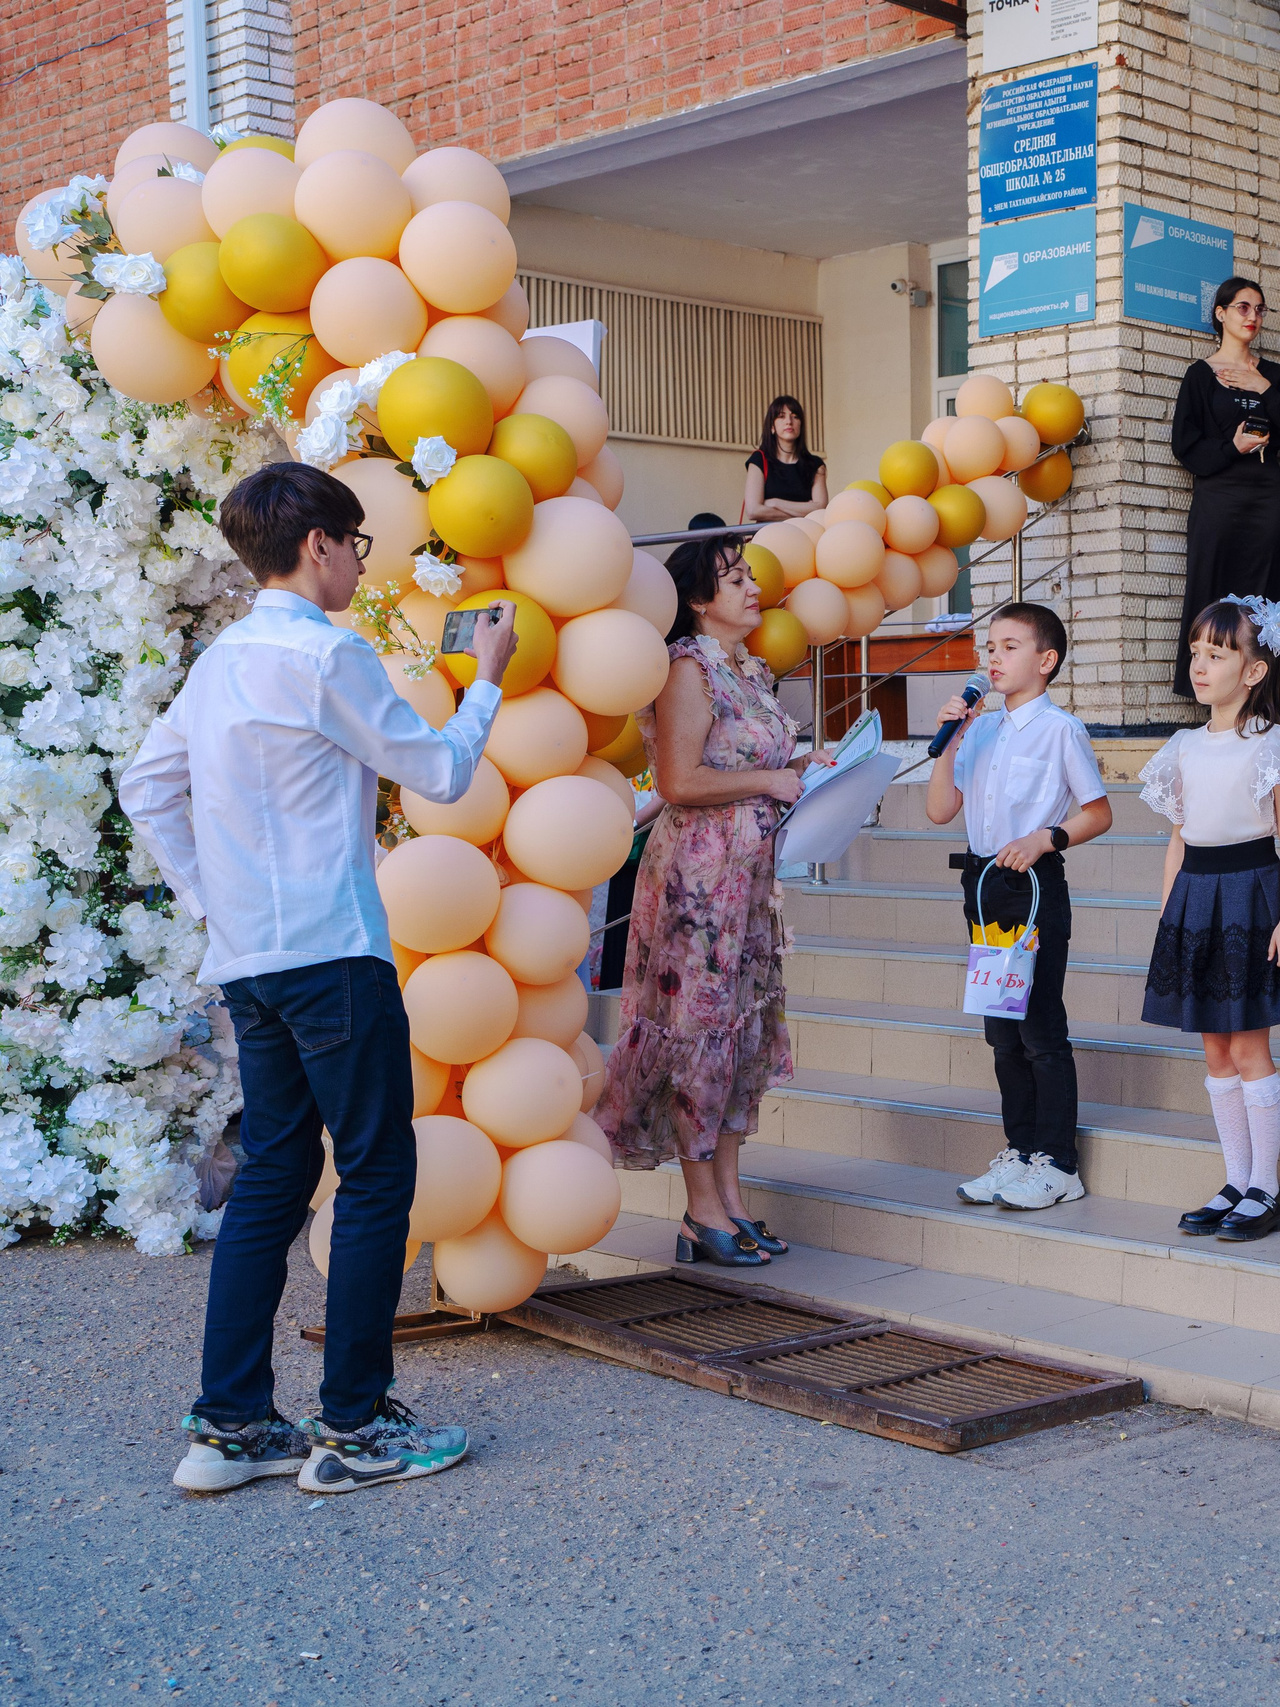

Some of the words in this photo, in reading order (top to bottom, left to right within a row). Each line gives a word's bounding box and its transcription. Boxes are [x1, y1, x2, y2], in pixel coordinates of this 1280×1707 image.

[984, 95, 1026, 112] МИНИСТЕРСТВО
[1026, 85, 1066, 101] ОБРАЗОВАНИЯ
[1067, 84, 1072, 92] И
[1073, 80, 1094, 91] НАУКИ
[1002, 82, 1037, 98] РОССИЙСКАЯ
[1038, 74, 1073, 88] ФЕДЕРАЦИЯ
[985, 112, 1034, 130] МУНИЦИПАЛЬНОЕ
[1035, 100, 1090, 118] ОБРАЗОВАТЕЛЬНОЕ
[1006, 100, 1043, 116] РЕСПУБЛИКИ
[1043, 95, 1067, 107] АДЫГЕЯ
[1016, 117, 1055, 132] УЧРЕЖДЕНИЕ
[1013, 132, 1057, 154] СРЕДНЯЯ
[980, 143, 1095, 179] ОБЩЕОБРАЗОВАТЕЛЬНАЯ
[1005, 173, 1040, 192] ШКОЛА
[1042, 170, 1053, 185] №
[1054, 168, 1066, 182] 25
[993, 201, 1009, 212] ЭНЕМ
[1009, 192, 1063, 208] ТАХТАМУКАЙСКОГО
[1063, 187, 1088, 198] РАЙОНА
[1168, 226, 1228, 251] ОБРАЗОВАНИЕ
[1022, 241, 1092, 264] ОБРАЗОВАНИЕ
[1134, 282, 1146, 293] НАМ
[1146, 284, 1164, 297] ВАЖНО
[1164, 288, 1178, 300] ВАШЕ
[1178, 291, 1198, 305] МНЕНИЕ
[988, 300, 1070, 320] национальныепроекты.рф
[970, 969, 992, 986] 11
[996, 973, 1026, 989] «Б»
